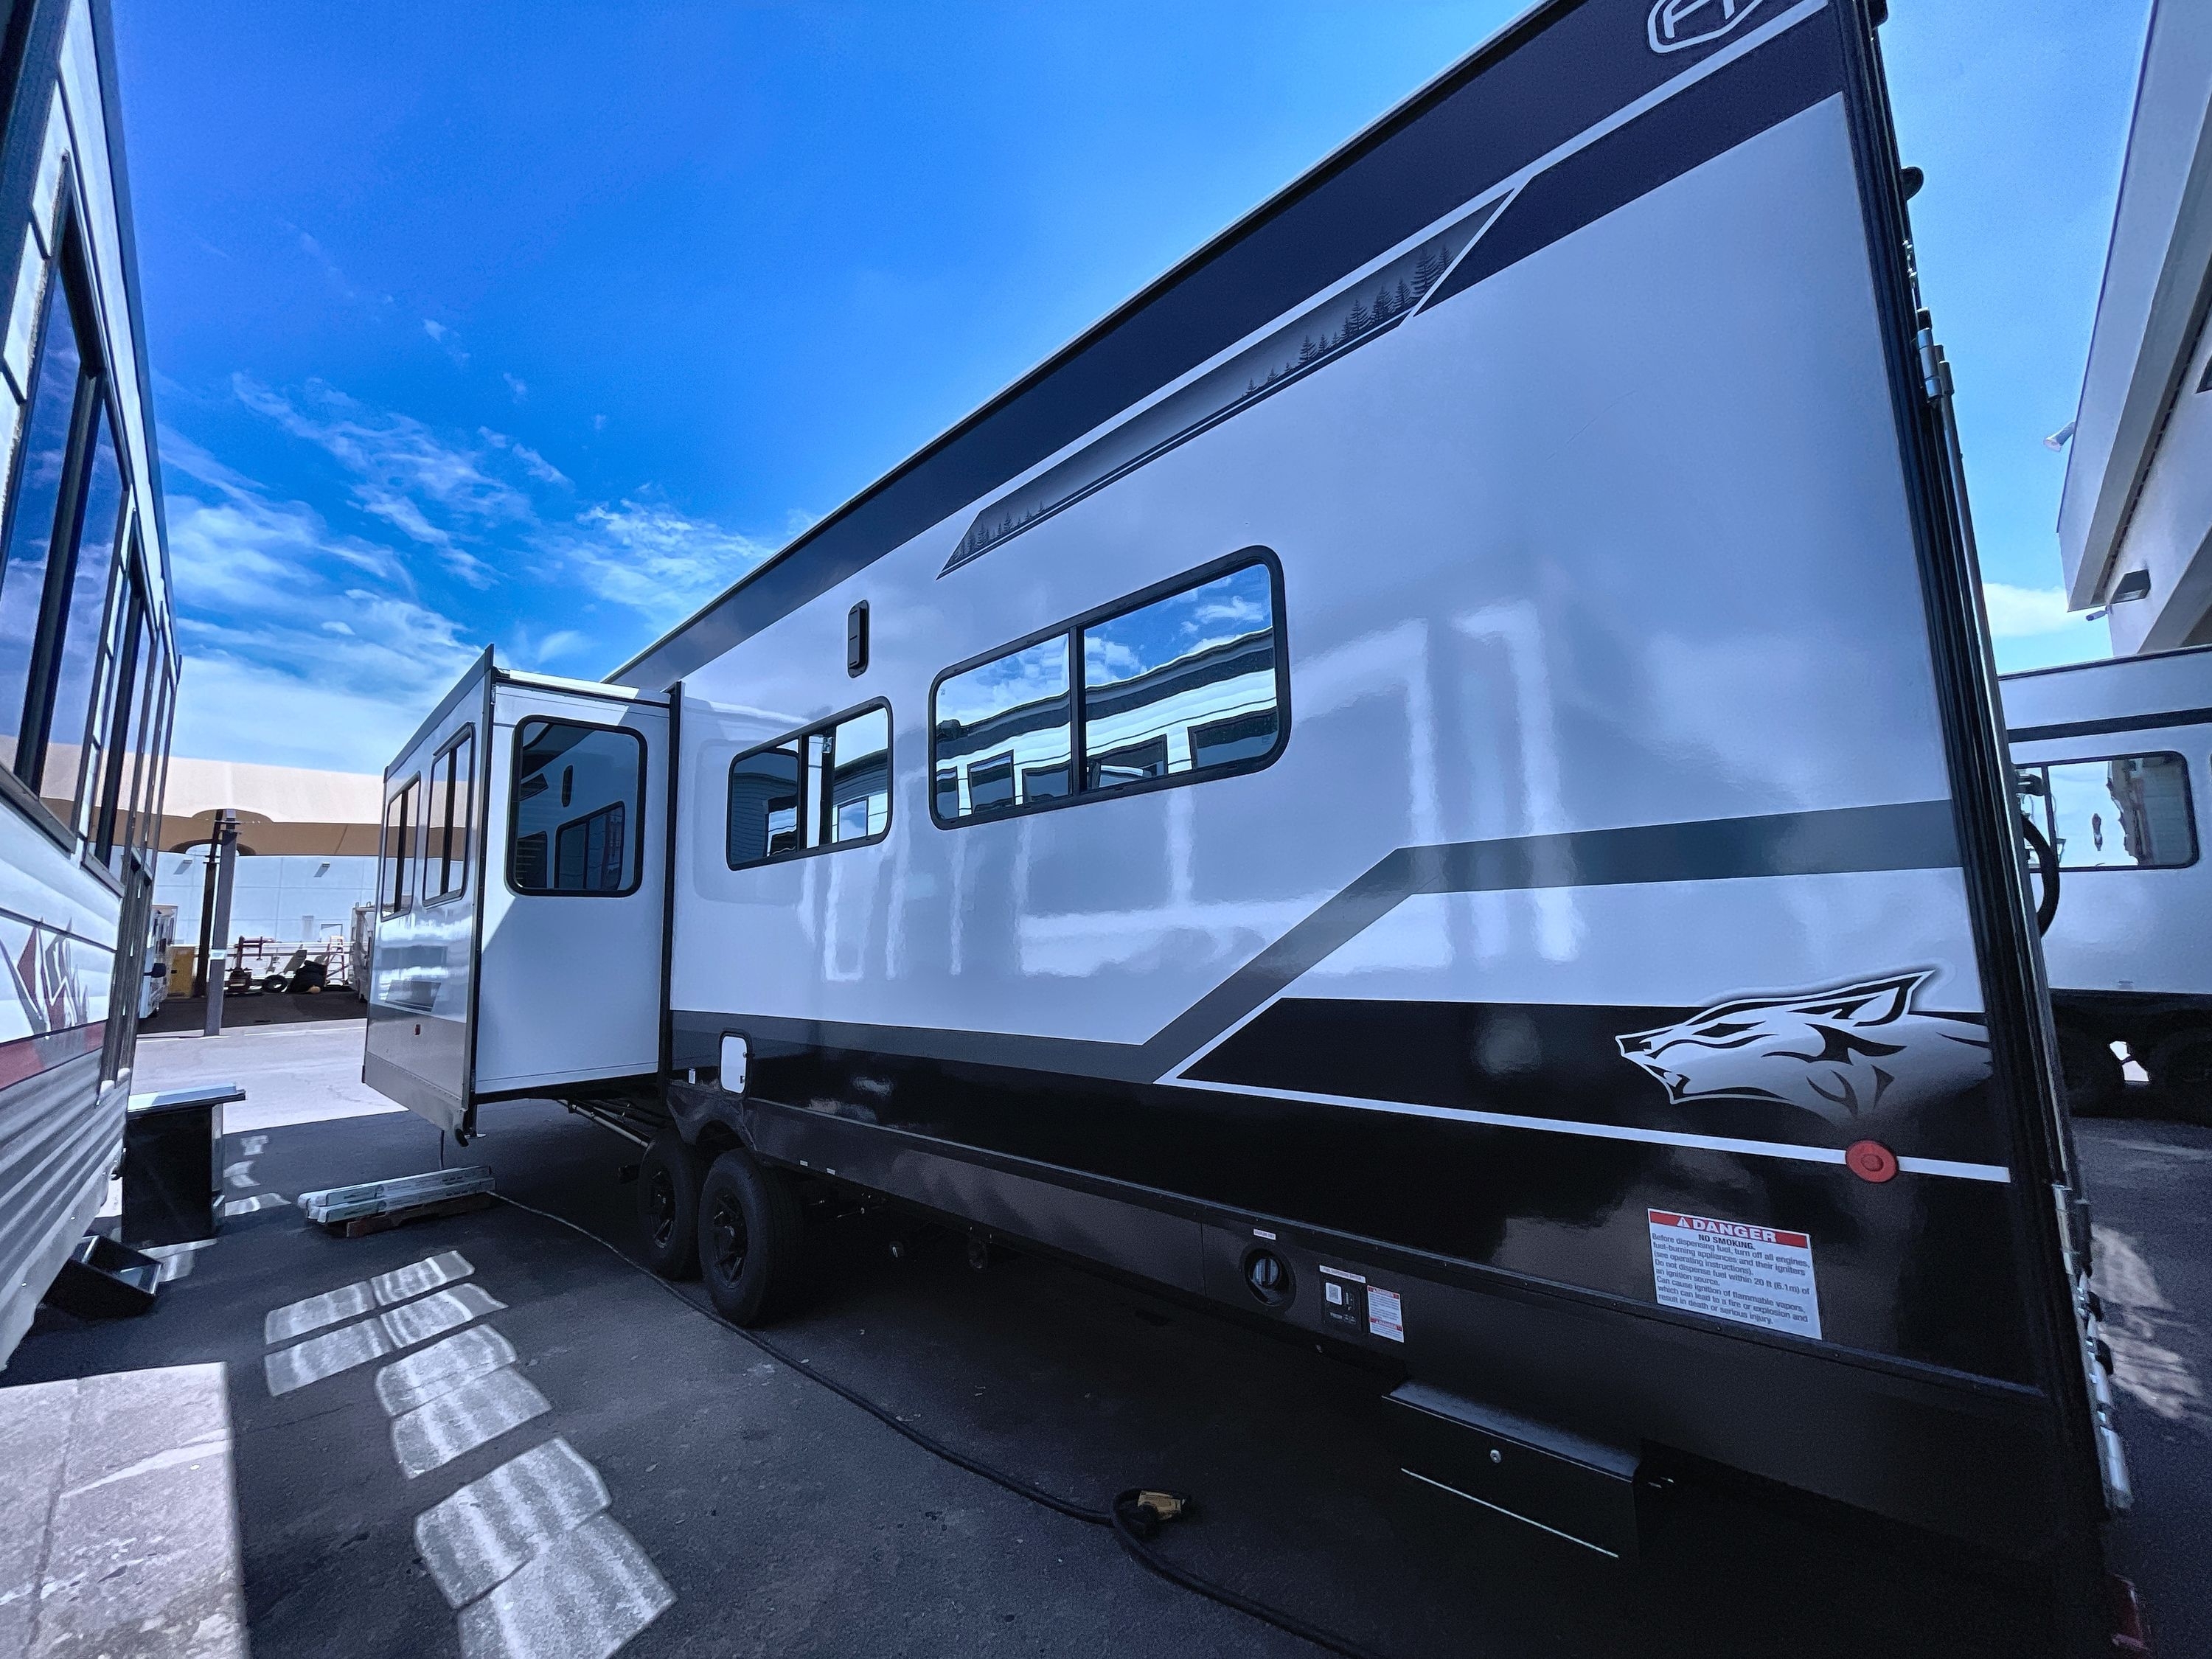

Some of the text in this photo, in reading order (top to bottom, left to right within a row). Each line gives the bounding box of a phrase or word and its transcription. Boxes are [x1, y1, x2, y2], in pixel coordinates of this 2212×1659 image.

[1652, 1234, 1674, 1242] Before
[1676, 1238, 1715, 1251] dispensing
[1693, 1219, 1776, 1242] DANGER
[1653, 1242, 1806, 1276] fuel-burning appliances and their igniters
[1654, 1251, 1669, 1259] (see
[1670, 1253, 1703, 1266] operating
[1666, 1269, 1692, 1281] ignition
[1679, 1263, 1711, 1276] dispense
[1713, 1270, 1727, 1278] fuel
[1729, 1273, 1752, 1283] within
[1774, 1281, 1800, 1293] (6.1m)
[1657, 1276, 1670, 1284] Can
[1672, 1279, 1693, 1288] cause
[1694, 1284, 1722, 1295] ignition
[1733, 1291, 1773, 1305] flammable
[1658, 1284, 1679, 1294] which
[1695, 1292, 1711, 1301] lead
[1728, 1299, 1741, 1307] fire
[1753, 1304, 1790, 1319] explosion
[1792, 1312, 1808, 1321] and
[1659, 1293, 1678, 1302] result
[1688, 1299, 1708, 1309] death
[1720, 1306, 1747, 1318] serious
